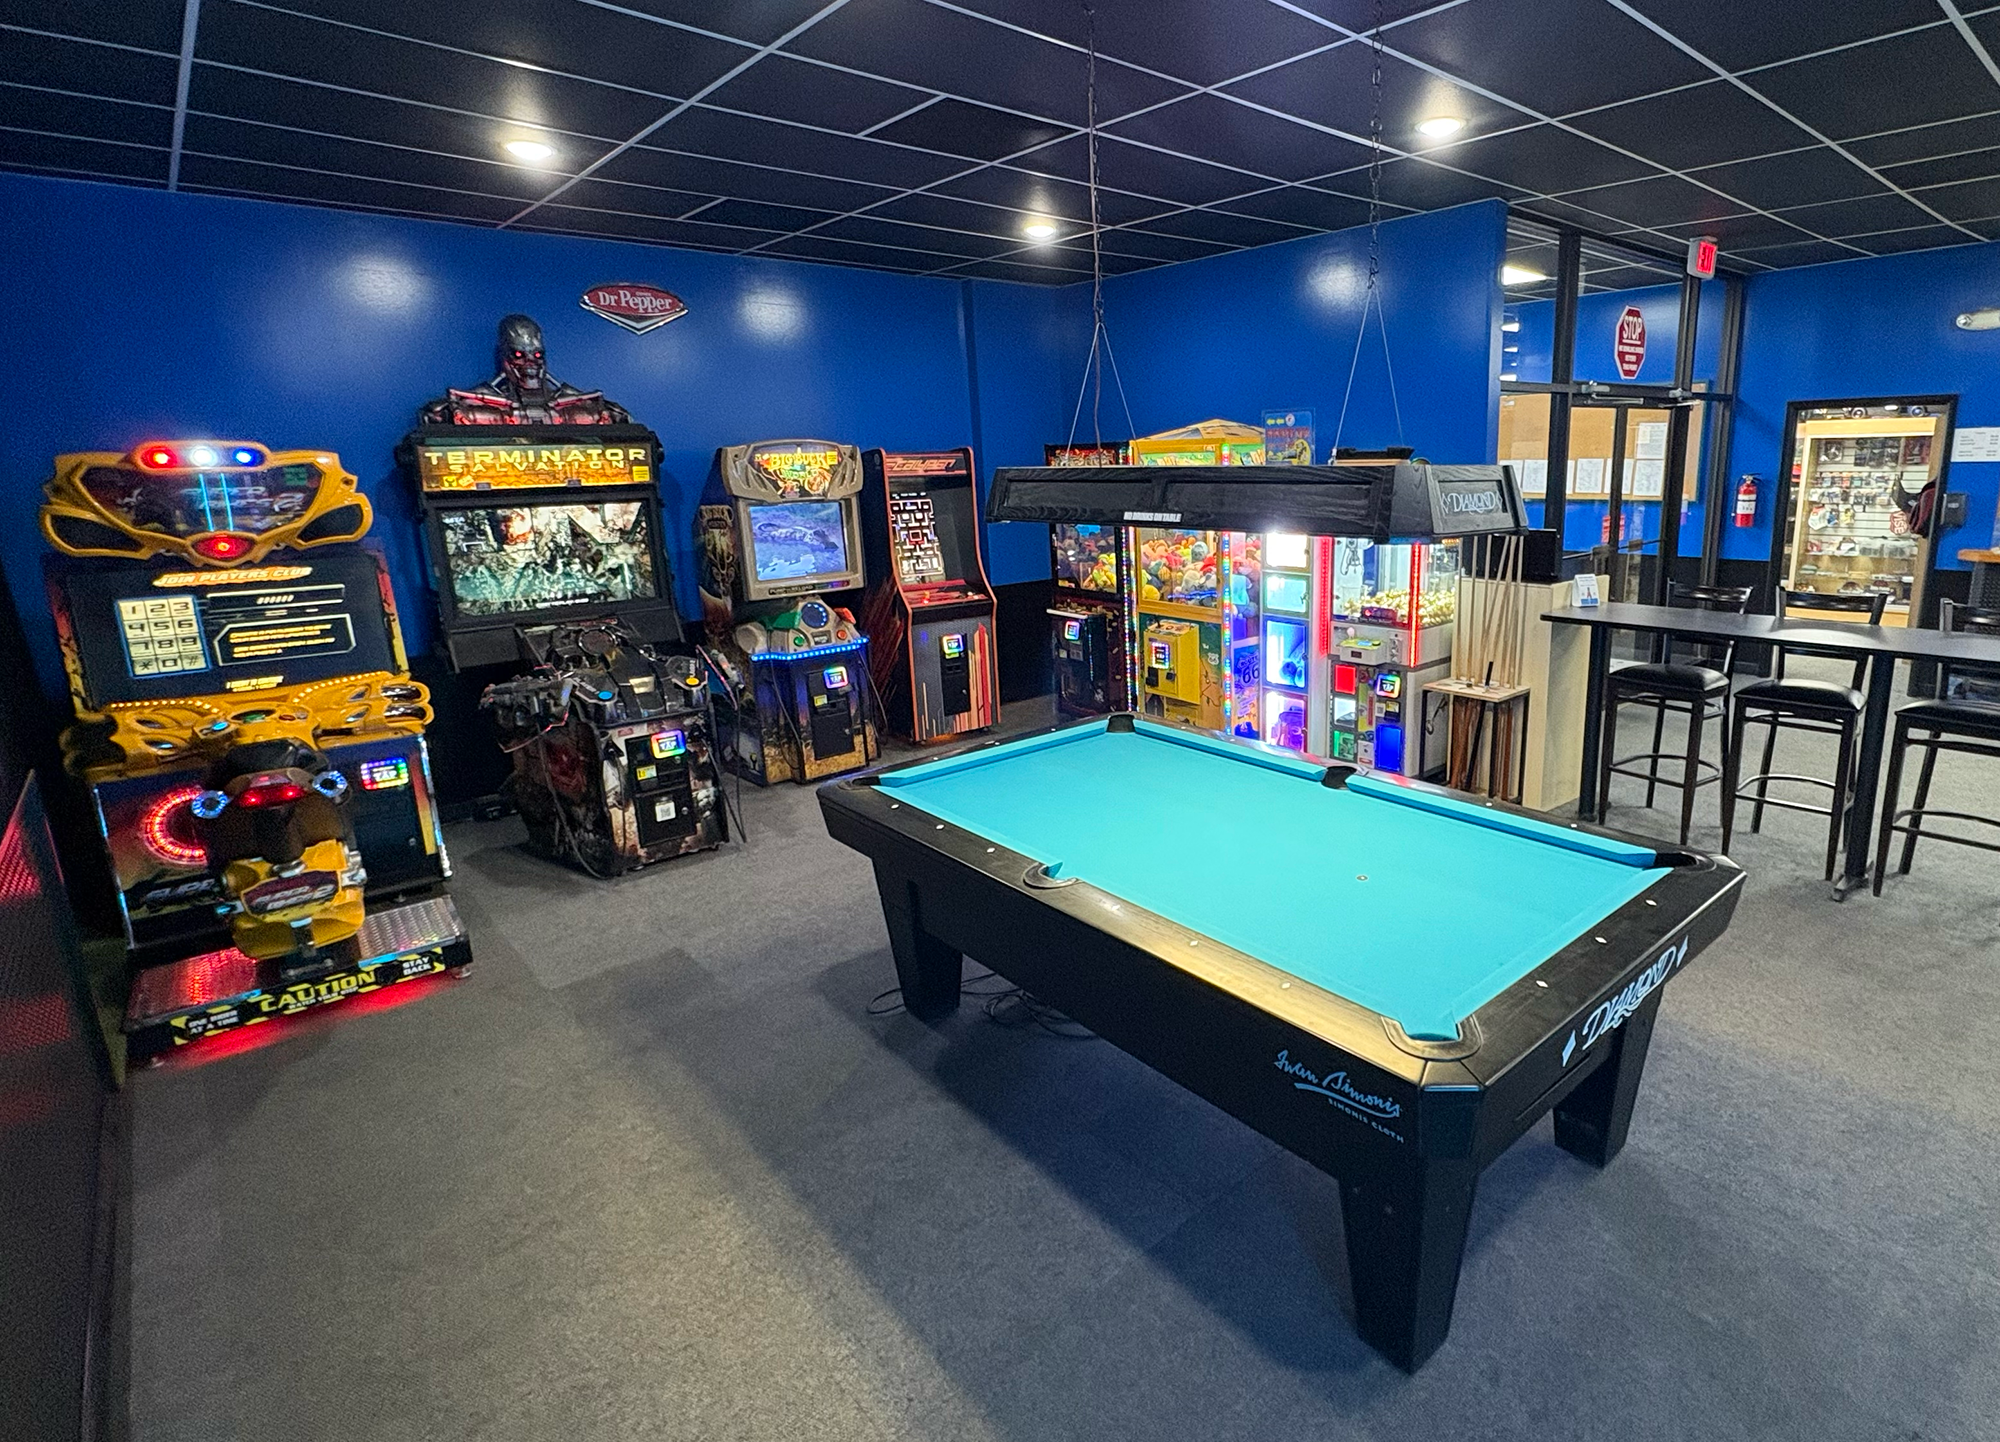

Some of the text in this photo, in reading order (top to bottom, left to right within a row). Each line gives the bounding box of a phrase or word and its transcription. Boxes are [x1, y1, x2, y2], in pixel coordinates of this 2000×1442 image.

[598, 290, 672, 313] Dr Pepper
[1622, 315, 1642, 340] STOP
[425, 448, 646, 465] TERMINATOR
[769, 453, 793, 470] BIG
[794, 452, 830, 469] BUCK
[449, 460, 625, 473] SALVATION
[1447, 491, 1496, 515] DIAMOND
[1893, 511, 1907, 533] VISE
[159, 566, 312, 586] JOIN PLAYERS CLUB
[150, 603, 166, 613] 2
[179, 602, 190, 611] 3
[128, 620, 193, 632] 4 5 6
[158, 639, 174, 649] 8
[181, 637, 197, 647] 9
[1242, 664, 1260, 684] 66
[373, 770, 397, 782] TAP
[313, 883, 336, 899] 2
[403, 957, 430, 969] STAY
[403, 963, 431, 976] BACK
[260, 971, 376, 1012] CAUTION
[1582, 946, 1677, 1050] DIAMOND
[190, 1025, 204, 1035] AT
[1322, 1071, 1400, 1117] Simonis
[1328, 1098, 1404, 1143] SIMONIS CLOTH
